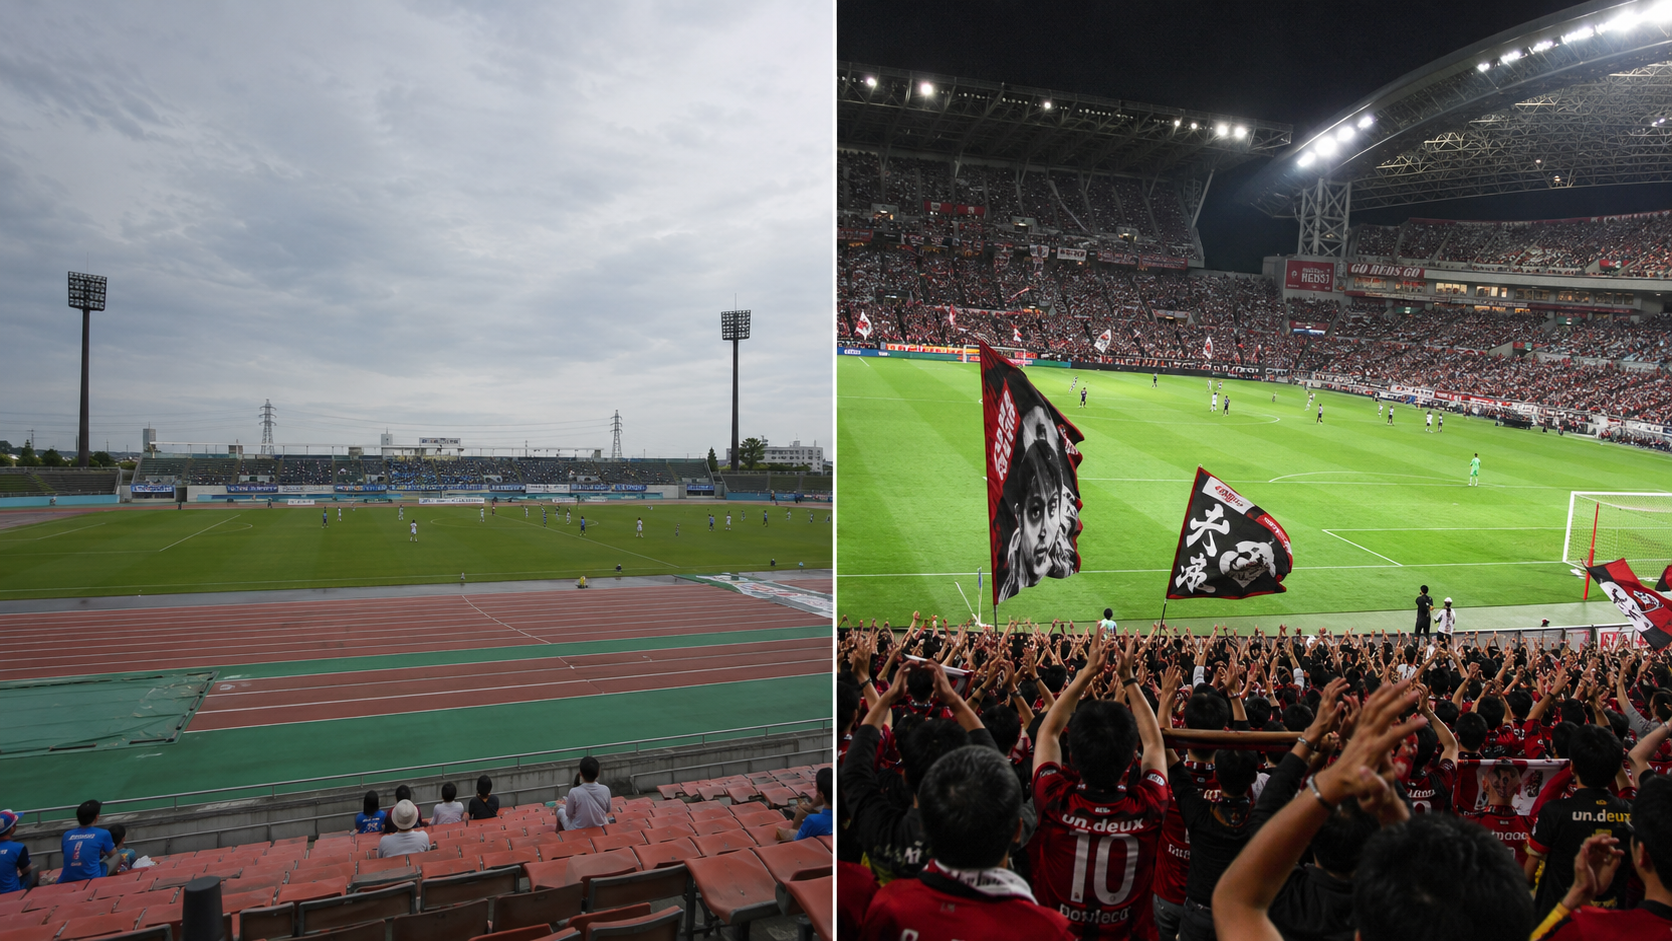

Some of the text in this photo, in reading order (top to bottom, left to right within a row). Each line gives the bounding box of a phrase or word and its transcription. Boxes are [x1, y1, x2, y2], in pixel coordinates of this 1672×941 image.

[1351, 263, 1422, 279] GO REDS GO
[1062, 814, 1144, 833] un.deux
[1069, 828, 1139, 906] 10
